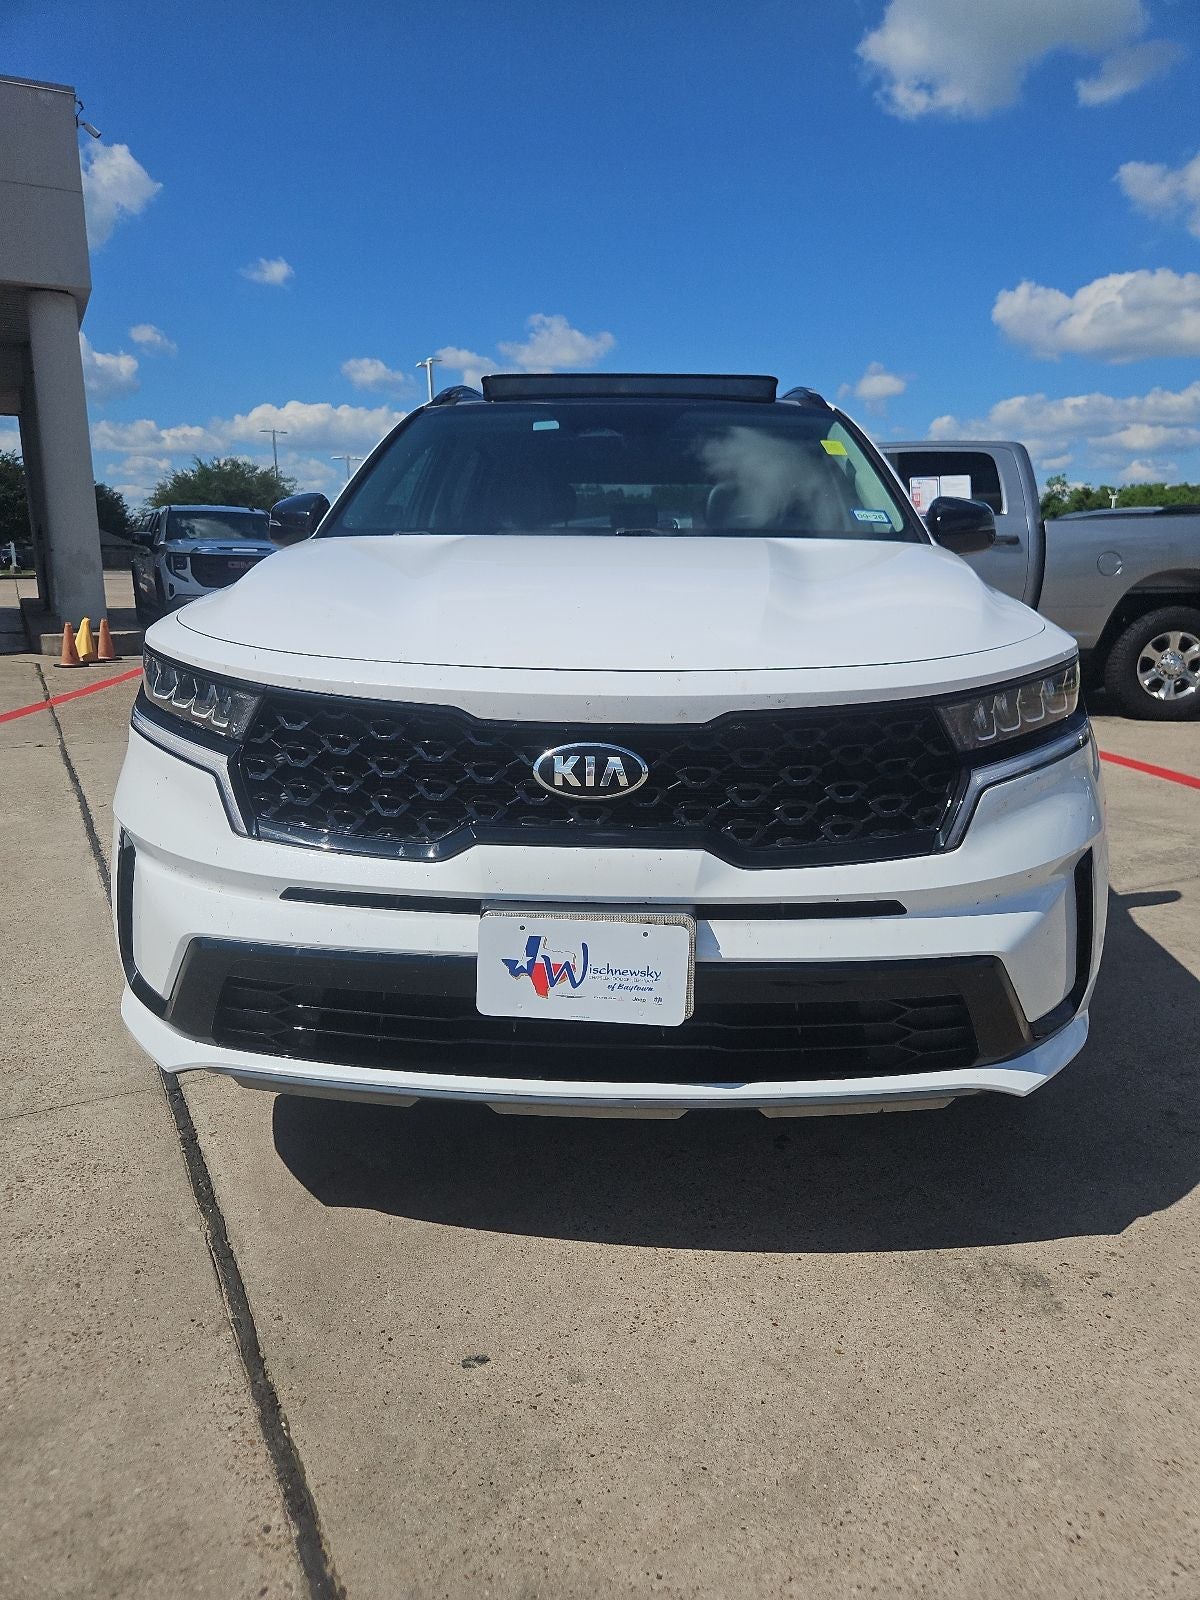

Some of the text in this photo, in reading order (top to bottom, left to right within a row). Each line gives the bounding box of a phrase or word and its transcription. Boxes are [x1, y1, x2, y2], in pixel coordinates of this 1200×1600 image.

[553, 755, 629, 787] KIA
[541, 942, 662, 988] Wischnewsky
[607, 983, 654, 992] of Baytown
